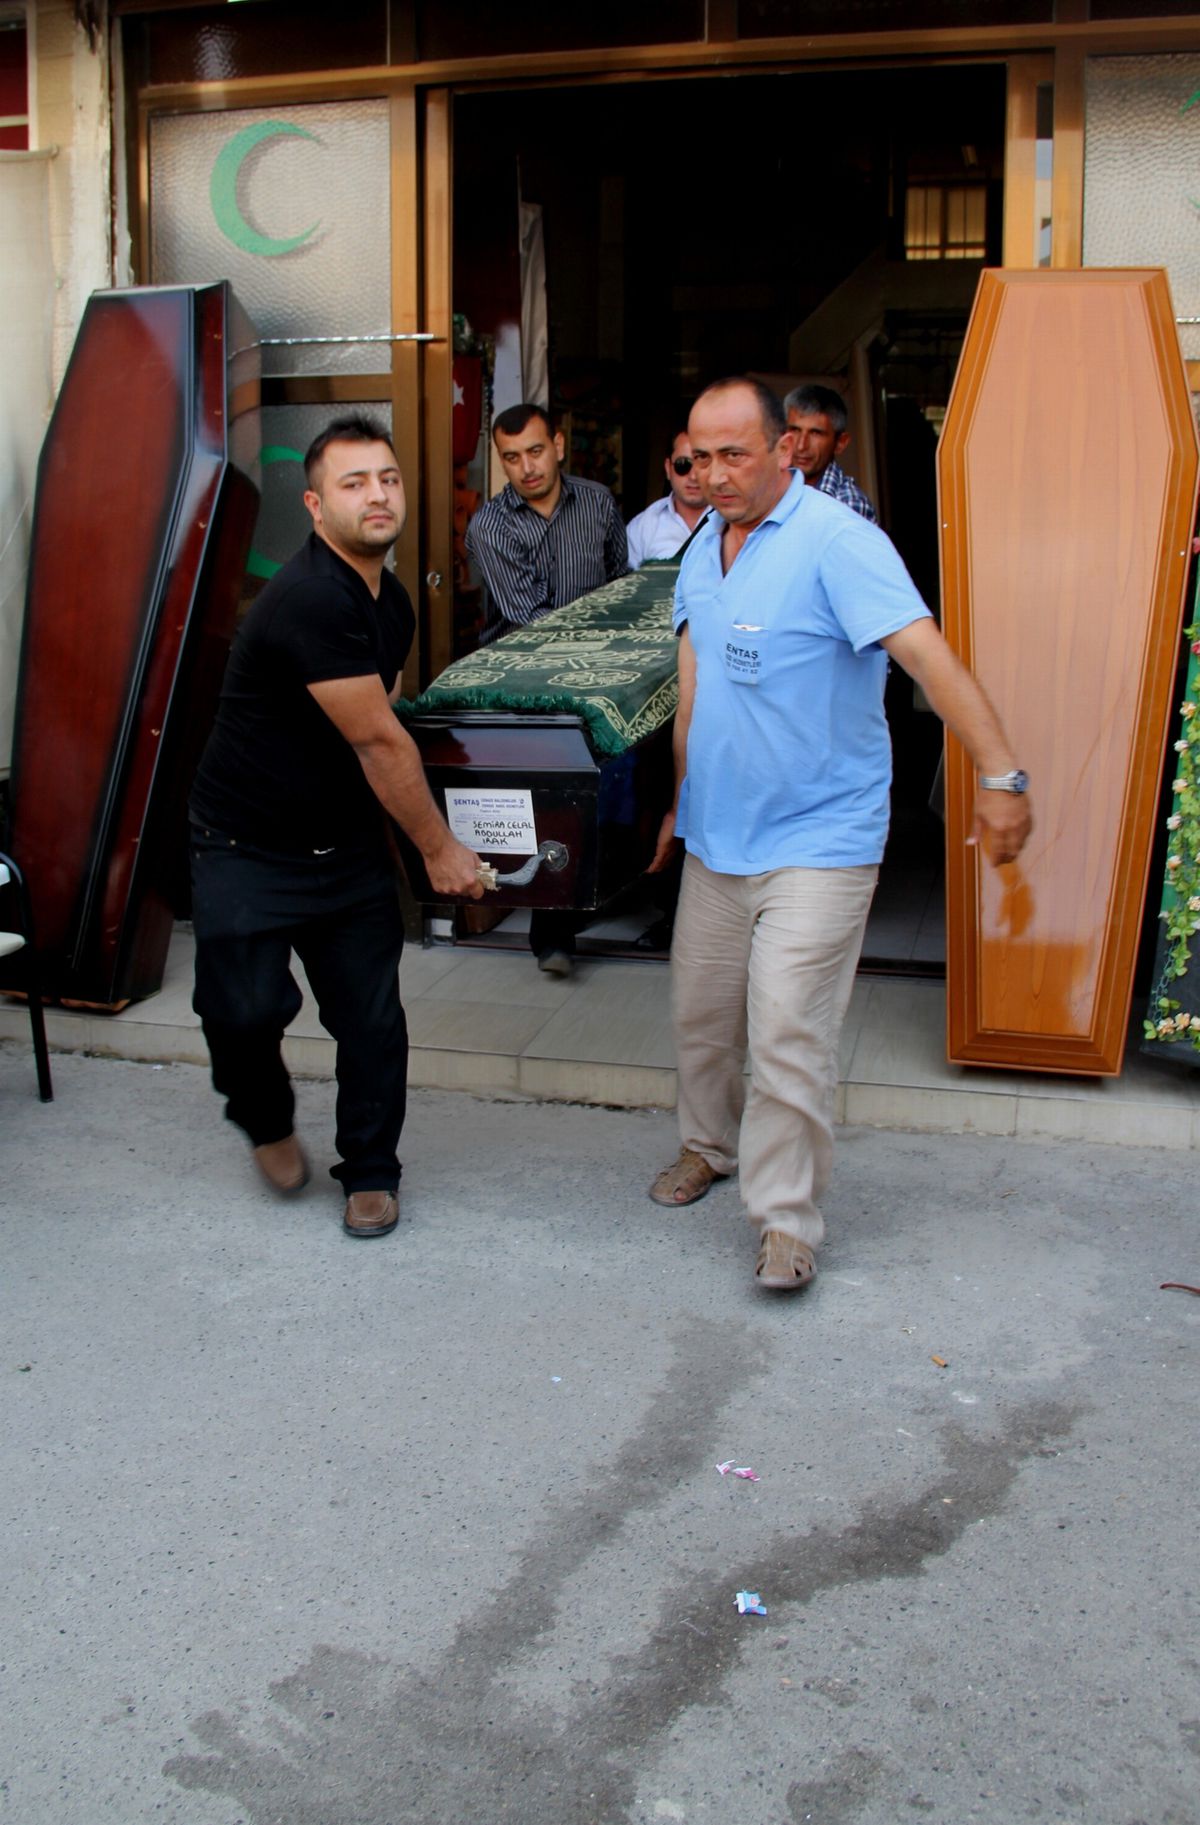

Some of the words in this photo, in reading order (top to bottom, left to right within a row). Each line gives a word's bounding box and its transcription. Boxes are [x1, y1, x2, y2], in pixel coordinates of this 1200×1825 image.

[726, 642, 759, 660] ENTAŞ
[507, 820, 534, 829] CELAL
[475, 829, 523, 838] ABDULLAH
[482, 837, 508, 846] IRAK
